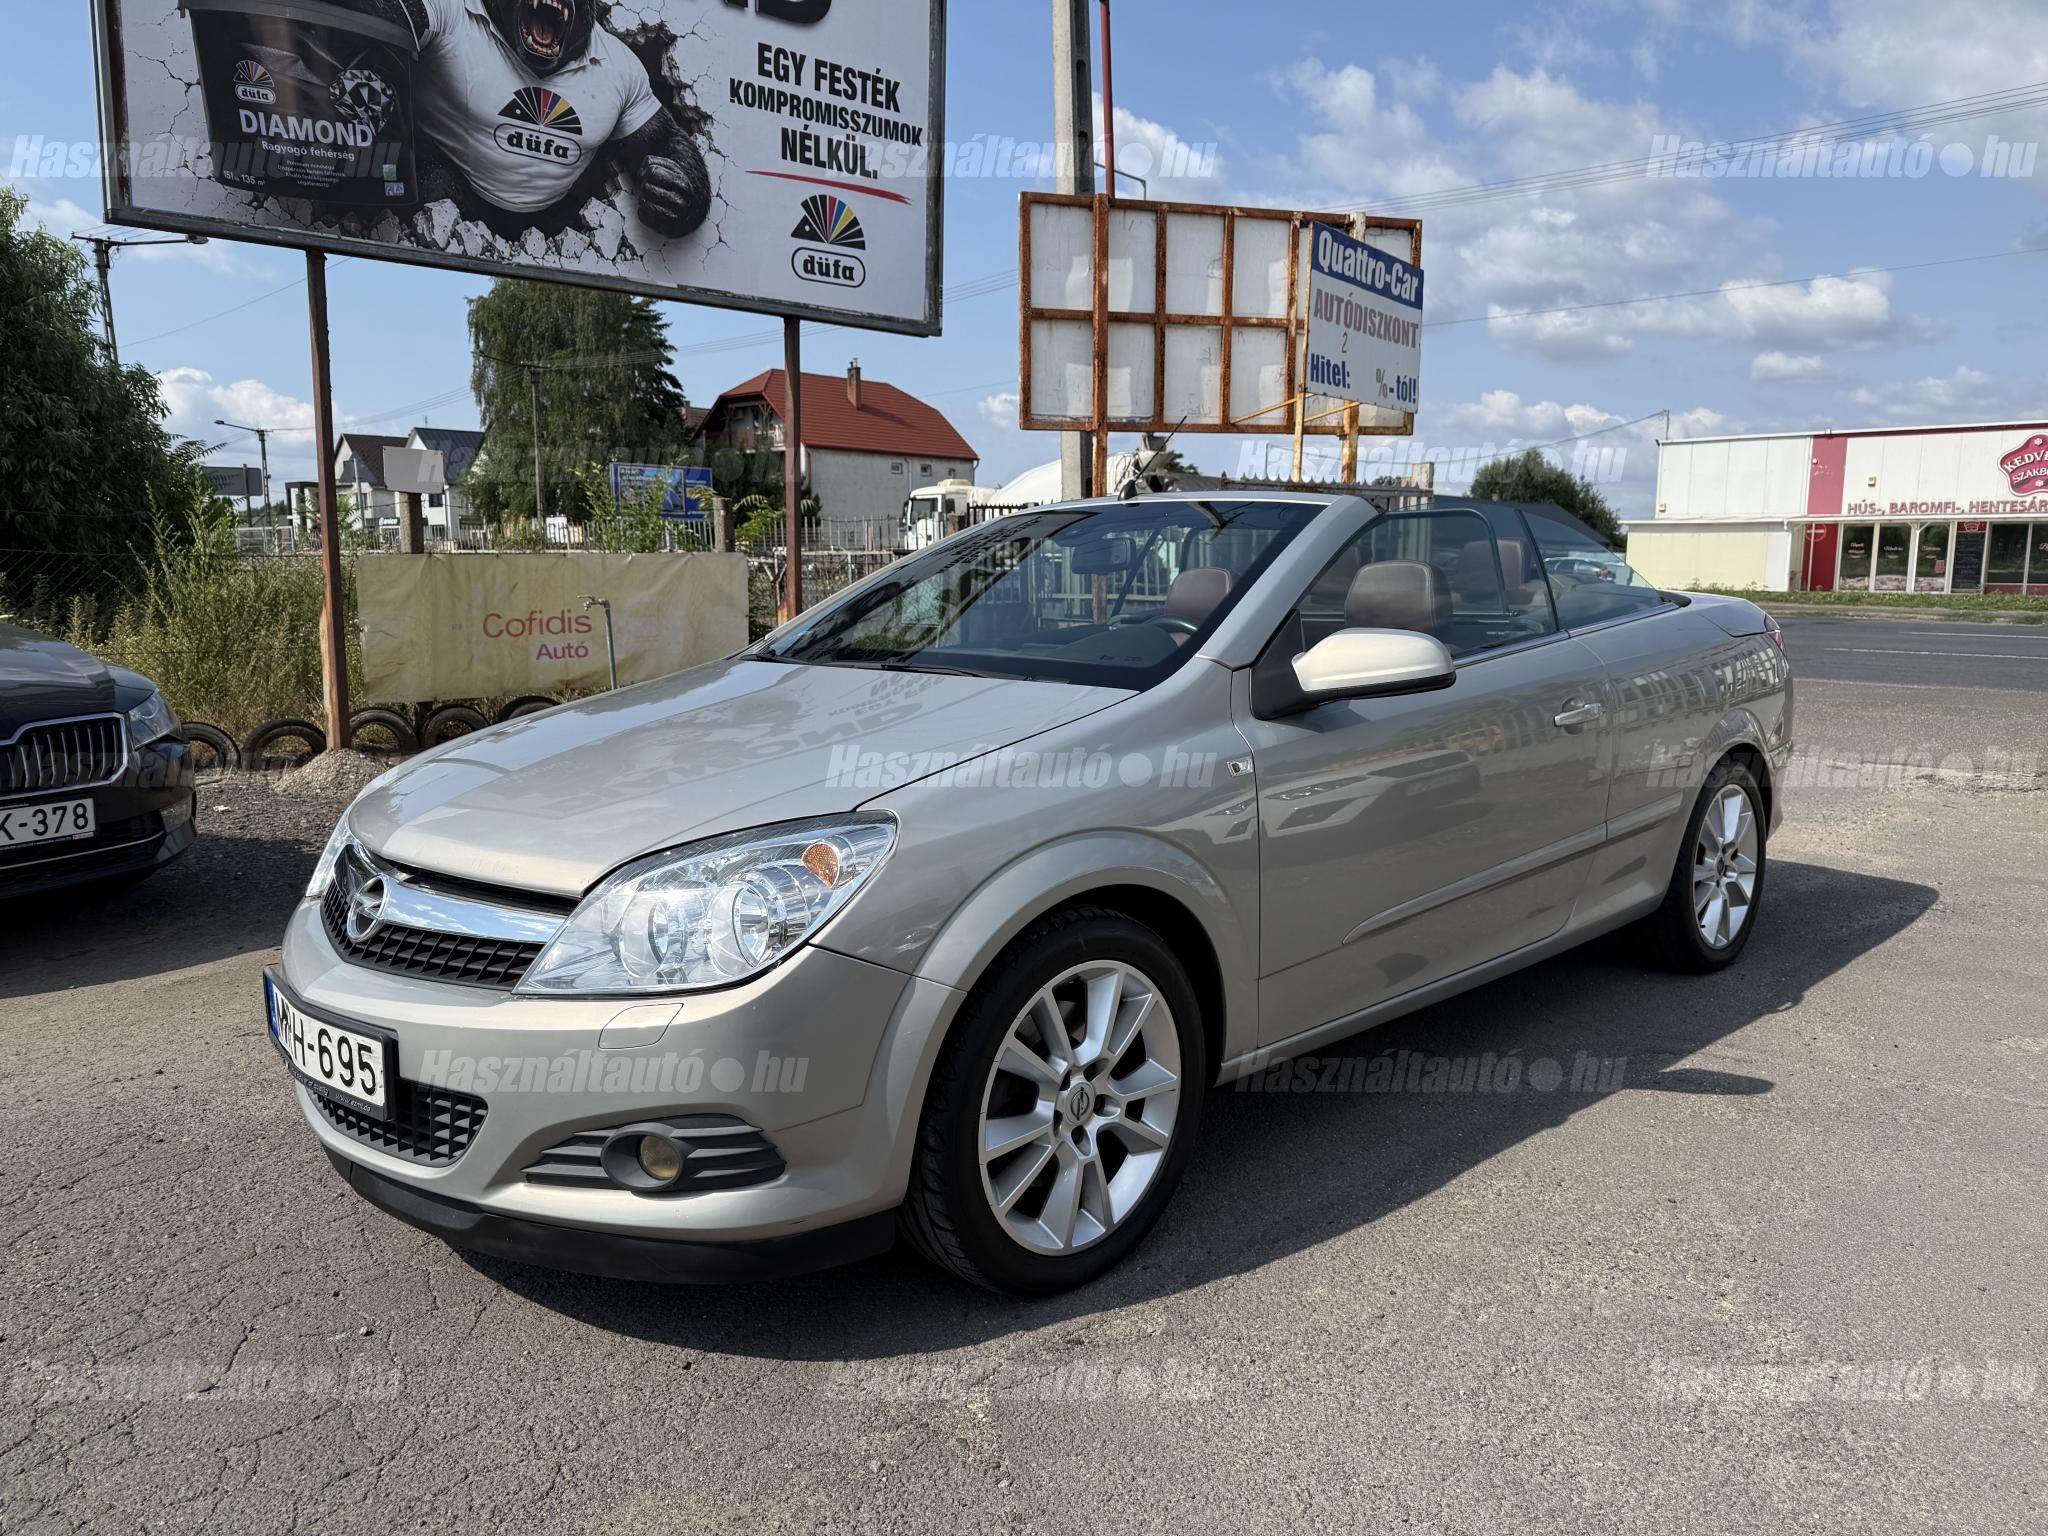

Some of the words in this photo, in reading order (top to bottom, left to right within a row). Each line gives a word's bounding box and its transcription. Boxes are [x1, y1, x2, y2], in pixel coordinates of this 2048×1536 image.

[240, 85, 271, 102] düfa
[757, 42, 807, 86] EGY
[813, 59, 901, 113] FESTÉK
[239, 107, 373, 148] DIAMOND
[729, 77, 924, 147] KOMPROMISSZUMOK
[261, 140, 306, 160] Ragyogó
[310, 143, 355, 163] fehérség
[506, 132, 570, 161] düfa
[780, 126, 878, 180] NÉLKÜL.
[803, 255, 856, 282] düfa
[1318, 230, 1419, 304] Quattro-Car
[1314, 288, 1419, 350] AUTÓDISZKONT
[1310, 353, 1351, 390] Hitel:
[2013, 467, 2048, 484] SZAKB
[482, 609, 593, 639] Cofidis
[535, 640, 589, 661] Autó
